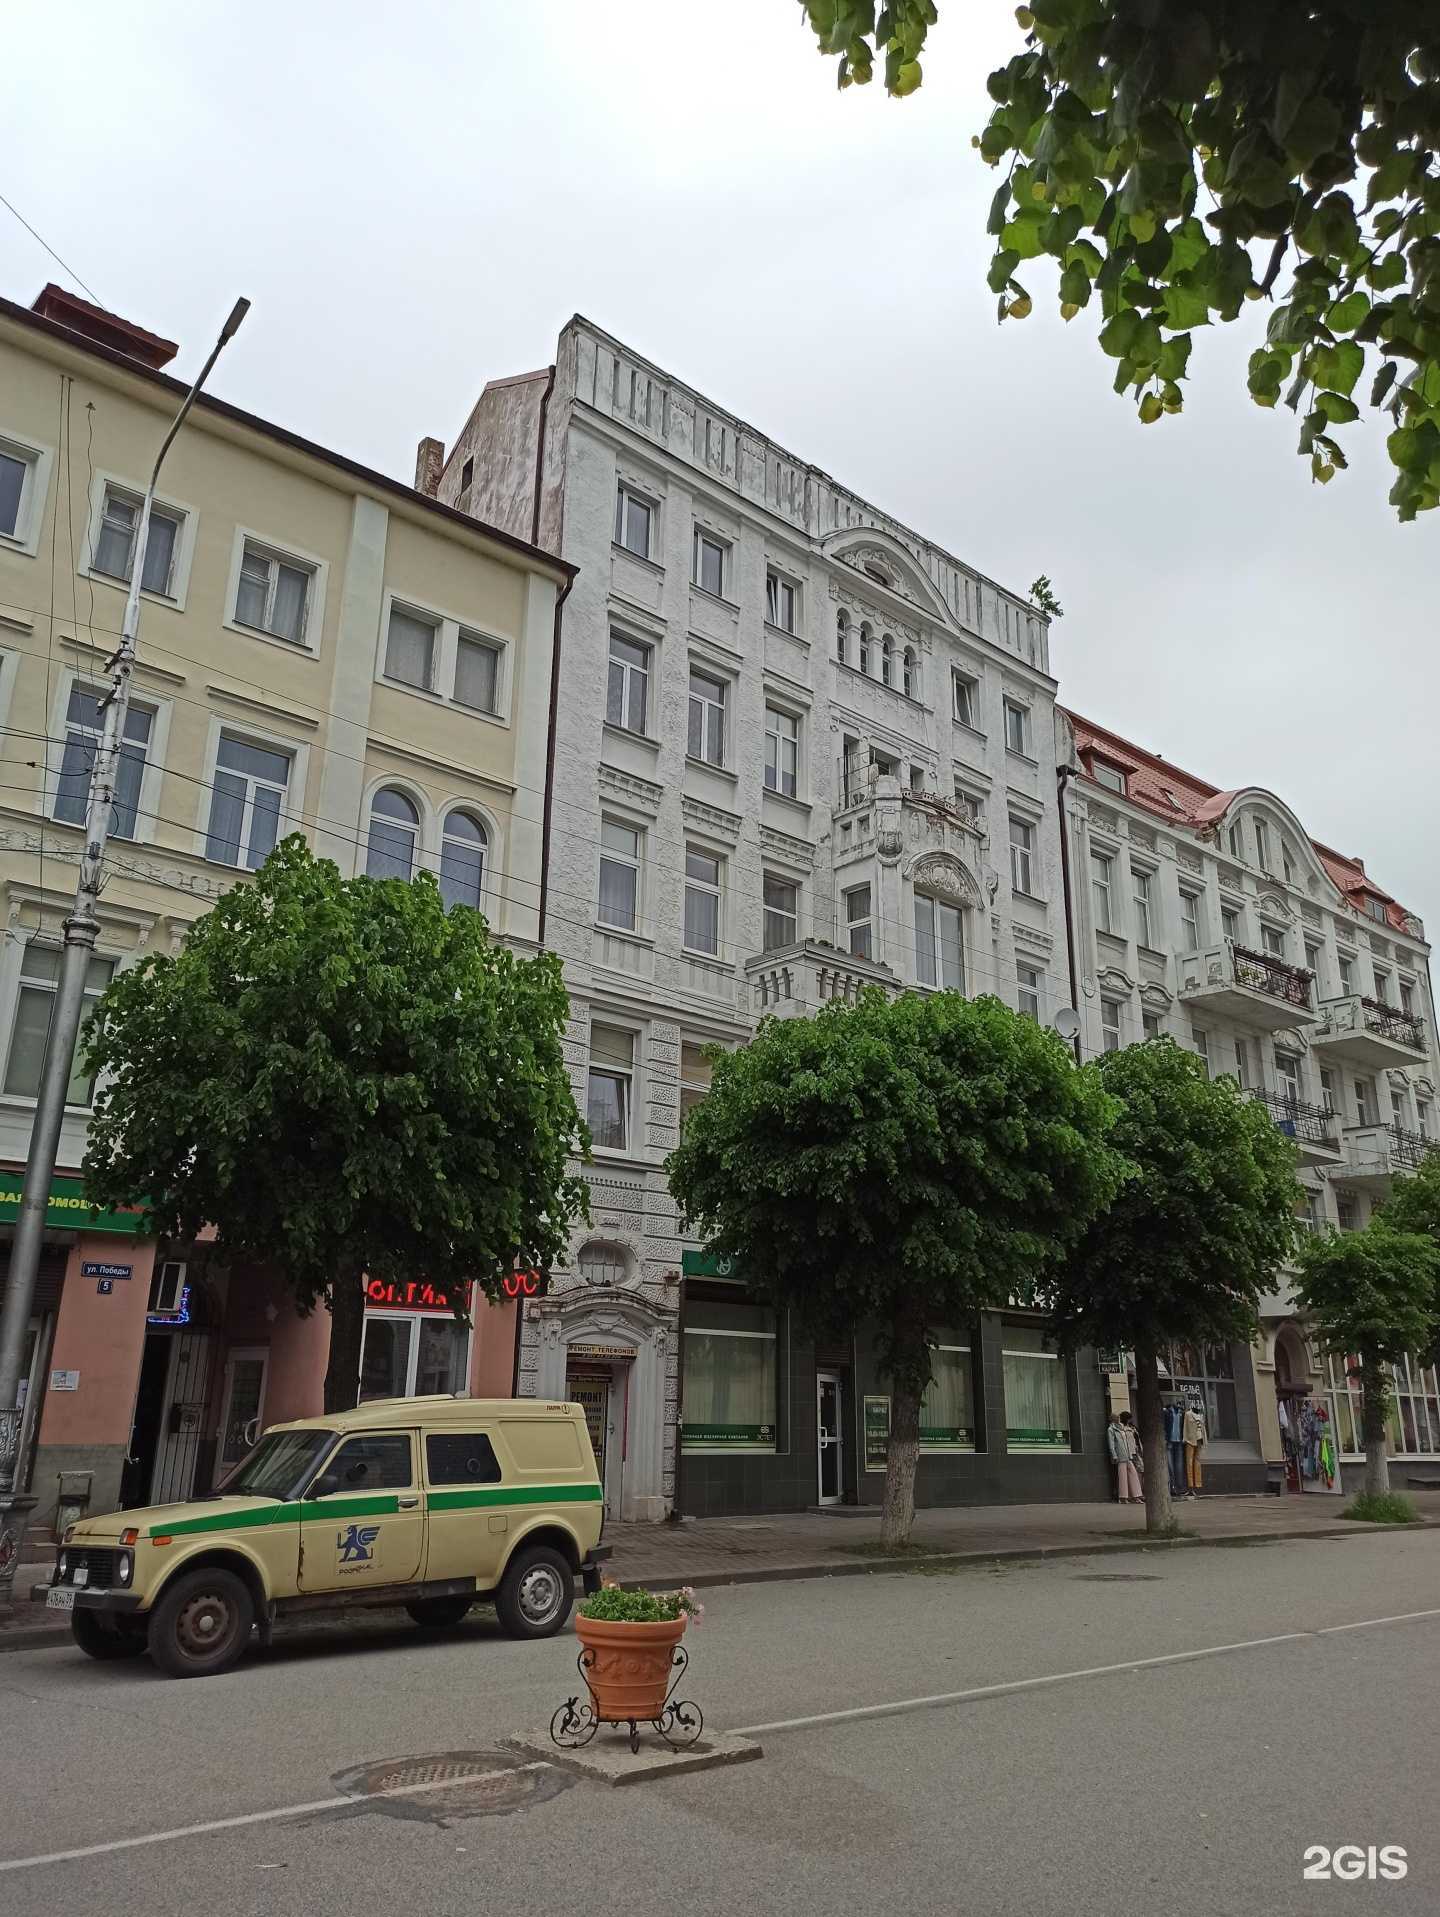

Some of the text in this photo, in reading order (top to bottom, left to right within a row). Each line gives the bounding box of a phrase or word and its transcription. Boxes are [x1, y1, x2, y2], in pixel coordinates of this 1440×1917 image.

[100, 1265, 129, 1275] Победы
[103, 1281, 109, 1291] 5
[568, 1344, 595, 1353] РЕМОНТ
[571, 1391, 603, 1403] РЕМОНТ
